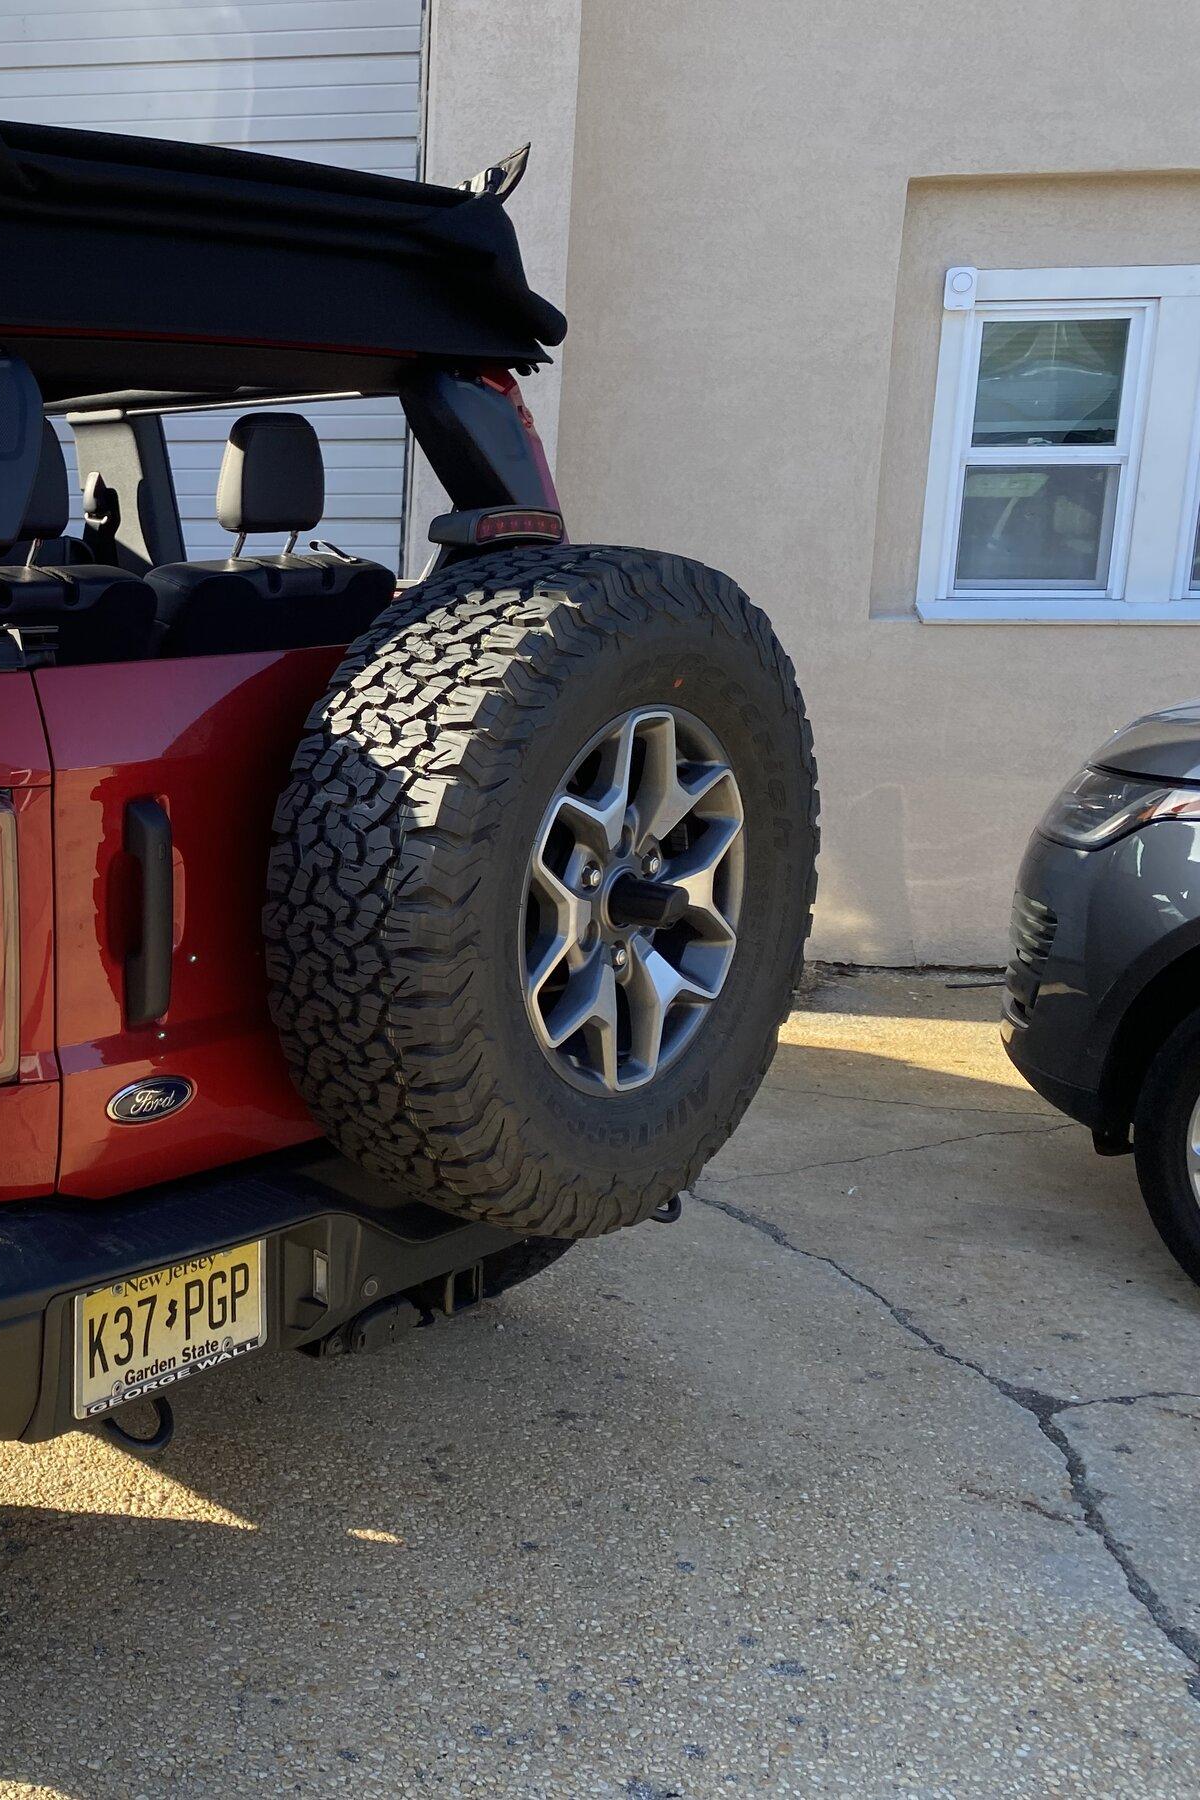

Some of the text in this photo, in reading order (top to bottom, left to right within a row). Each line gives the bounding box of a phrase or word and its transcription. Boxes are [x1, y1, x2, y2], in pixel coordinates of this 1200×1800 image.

[130, 1088, 175, 1115] Ford
[123, 1255, 216, 1297] New Jersey
[88, 1262, 249, 1379] K37 PGP
[89, 1342, 258, 1414] GEORGE WALL
[124, 1340, 219, 1386] Garden State
